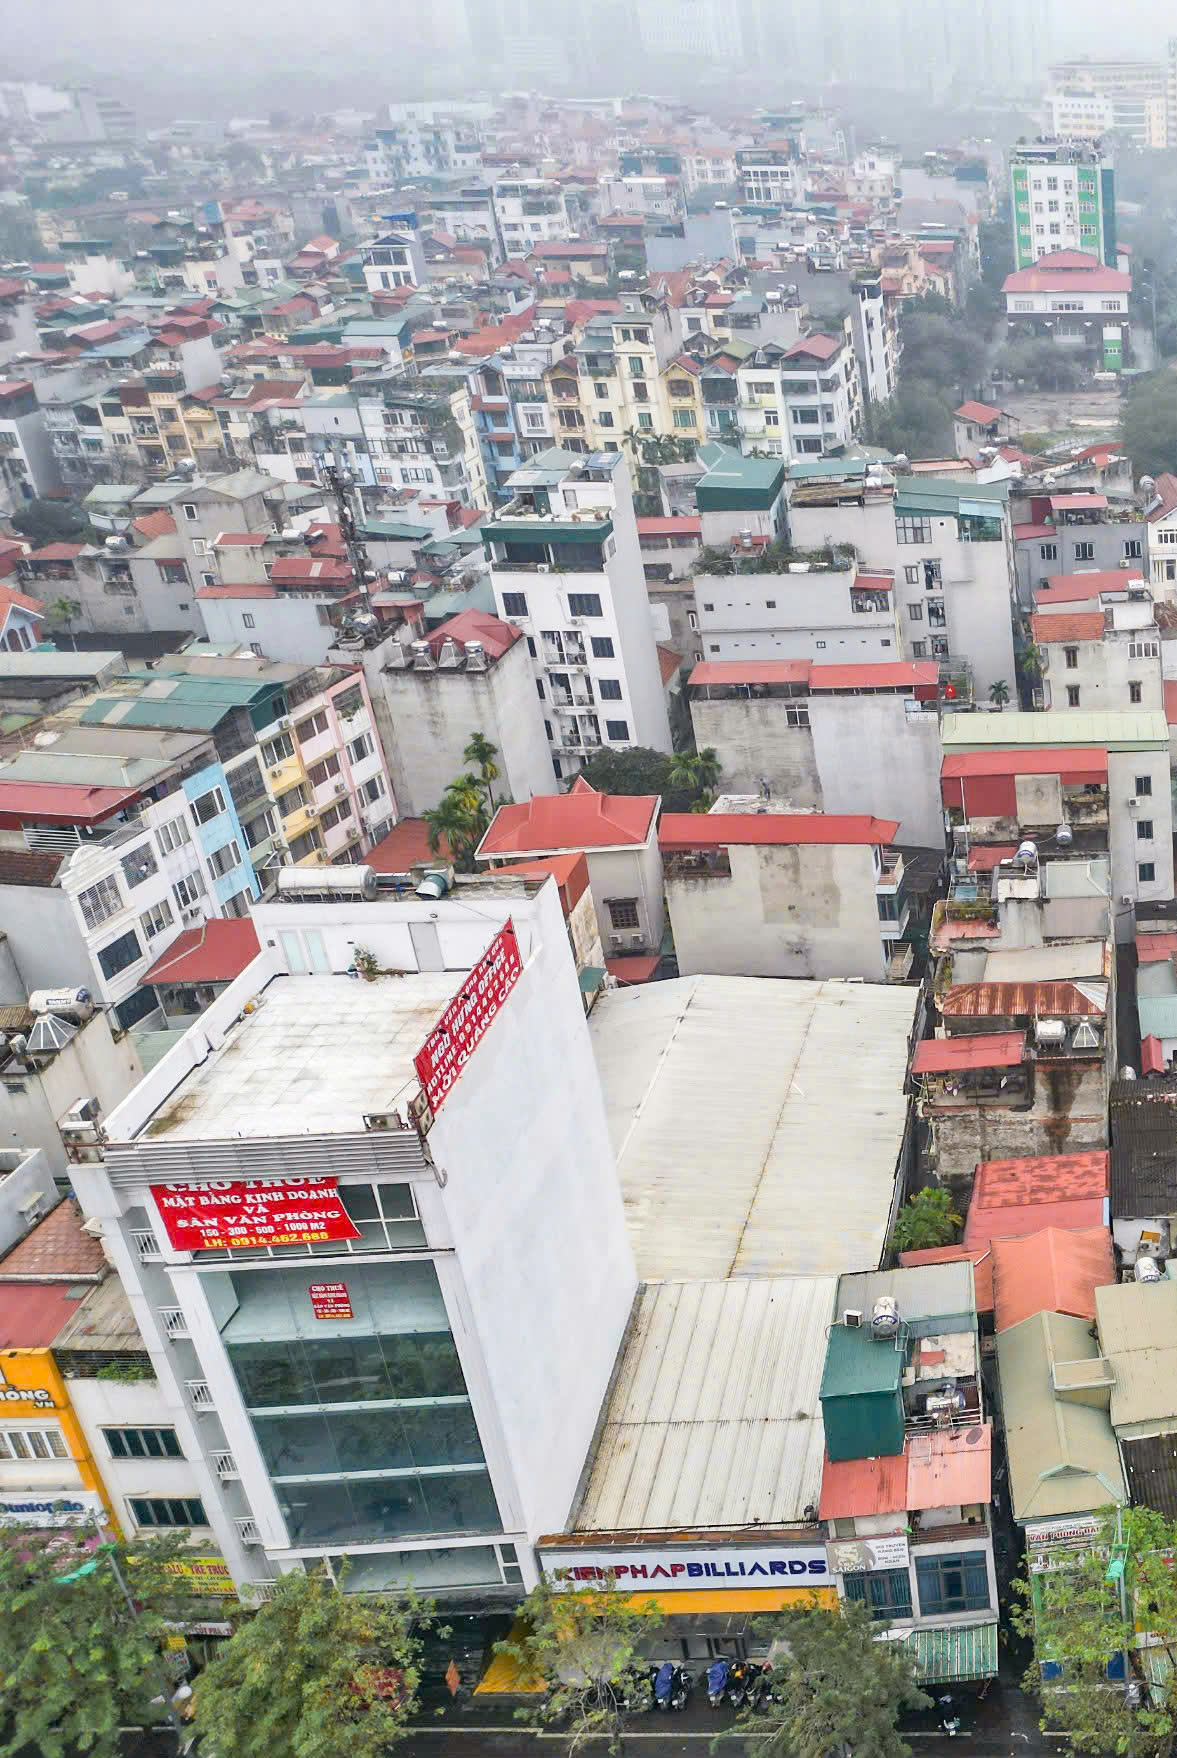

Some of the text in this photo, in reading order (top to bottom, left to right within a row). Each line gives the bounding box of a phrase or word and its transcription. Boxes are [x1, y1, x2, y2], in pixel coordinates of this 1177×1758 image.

[244, 1190, 285, 1204] KINH
[288, 1188, 338, 1200] DOANH
[272, 1210, 341, 1223] PHÒNG
[310, 1221, 326, 1230] M2
[204, 1238, 228, 1248] LH:
